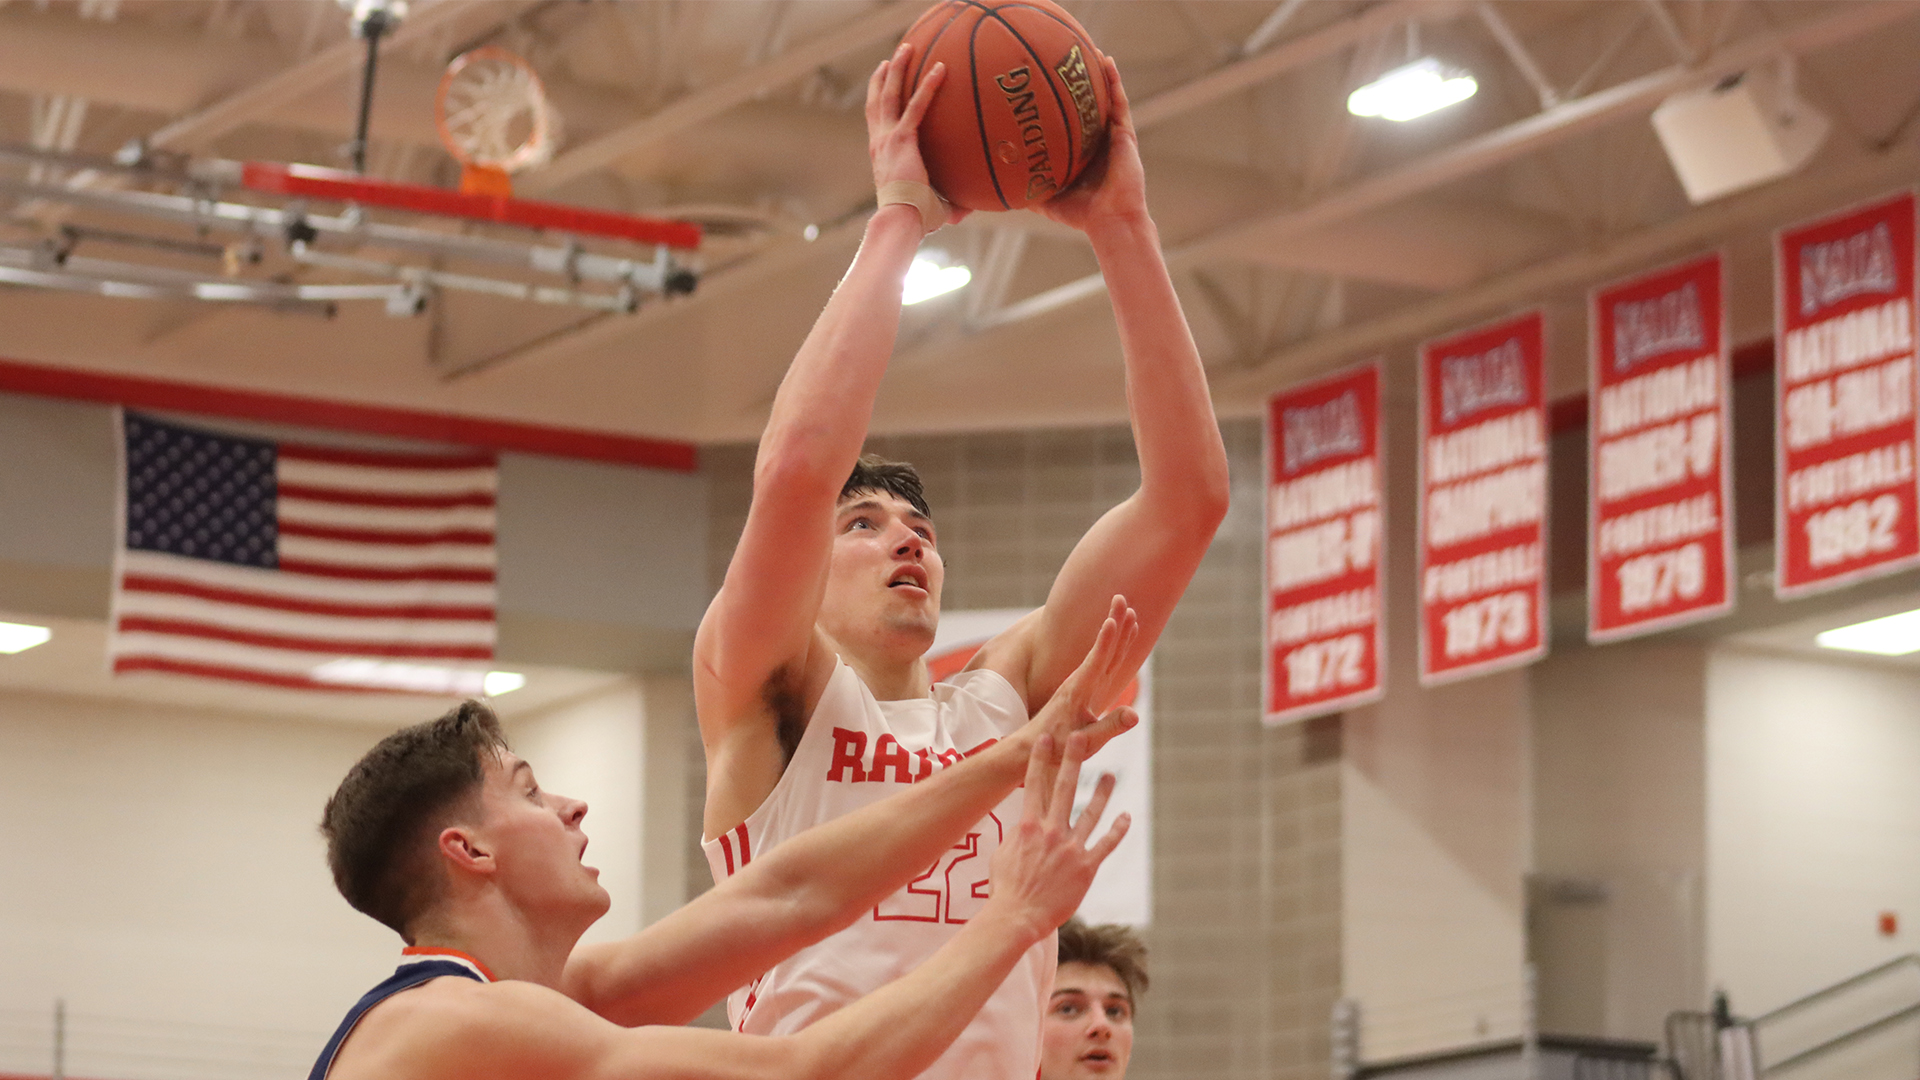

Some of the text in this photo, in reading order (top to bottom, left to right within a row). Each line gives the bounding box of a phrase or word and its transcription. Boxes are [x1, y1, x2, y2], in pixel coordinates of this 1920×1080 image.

[995, 65, 1057, 200] SPALDING
[1786, 297, 1912, 382] NATIONAL
[1600, 353, 1717, 438] NATIONAL
[1427, 406, 1545, 486] NATIONAL
[1788, 440, 1913, 512] FOOTBALL
[1270, 457, 1378, 533] NATIONAL
[1600, 490, 1718, 558] FOOTBALL
[1424, 542, 1543, 605] FOOTBALL
[1270, 585, 1376, 646] FOOTBALL
[1441, 590, 1530, 658] 1973
[1283, 632, 1364, 697] 1972
